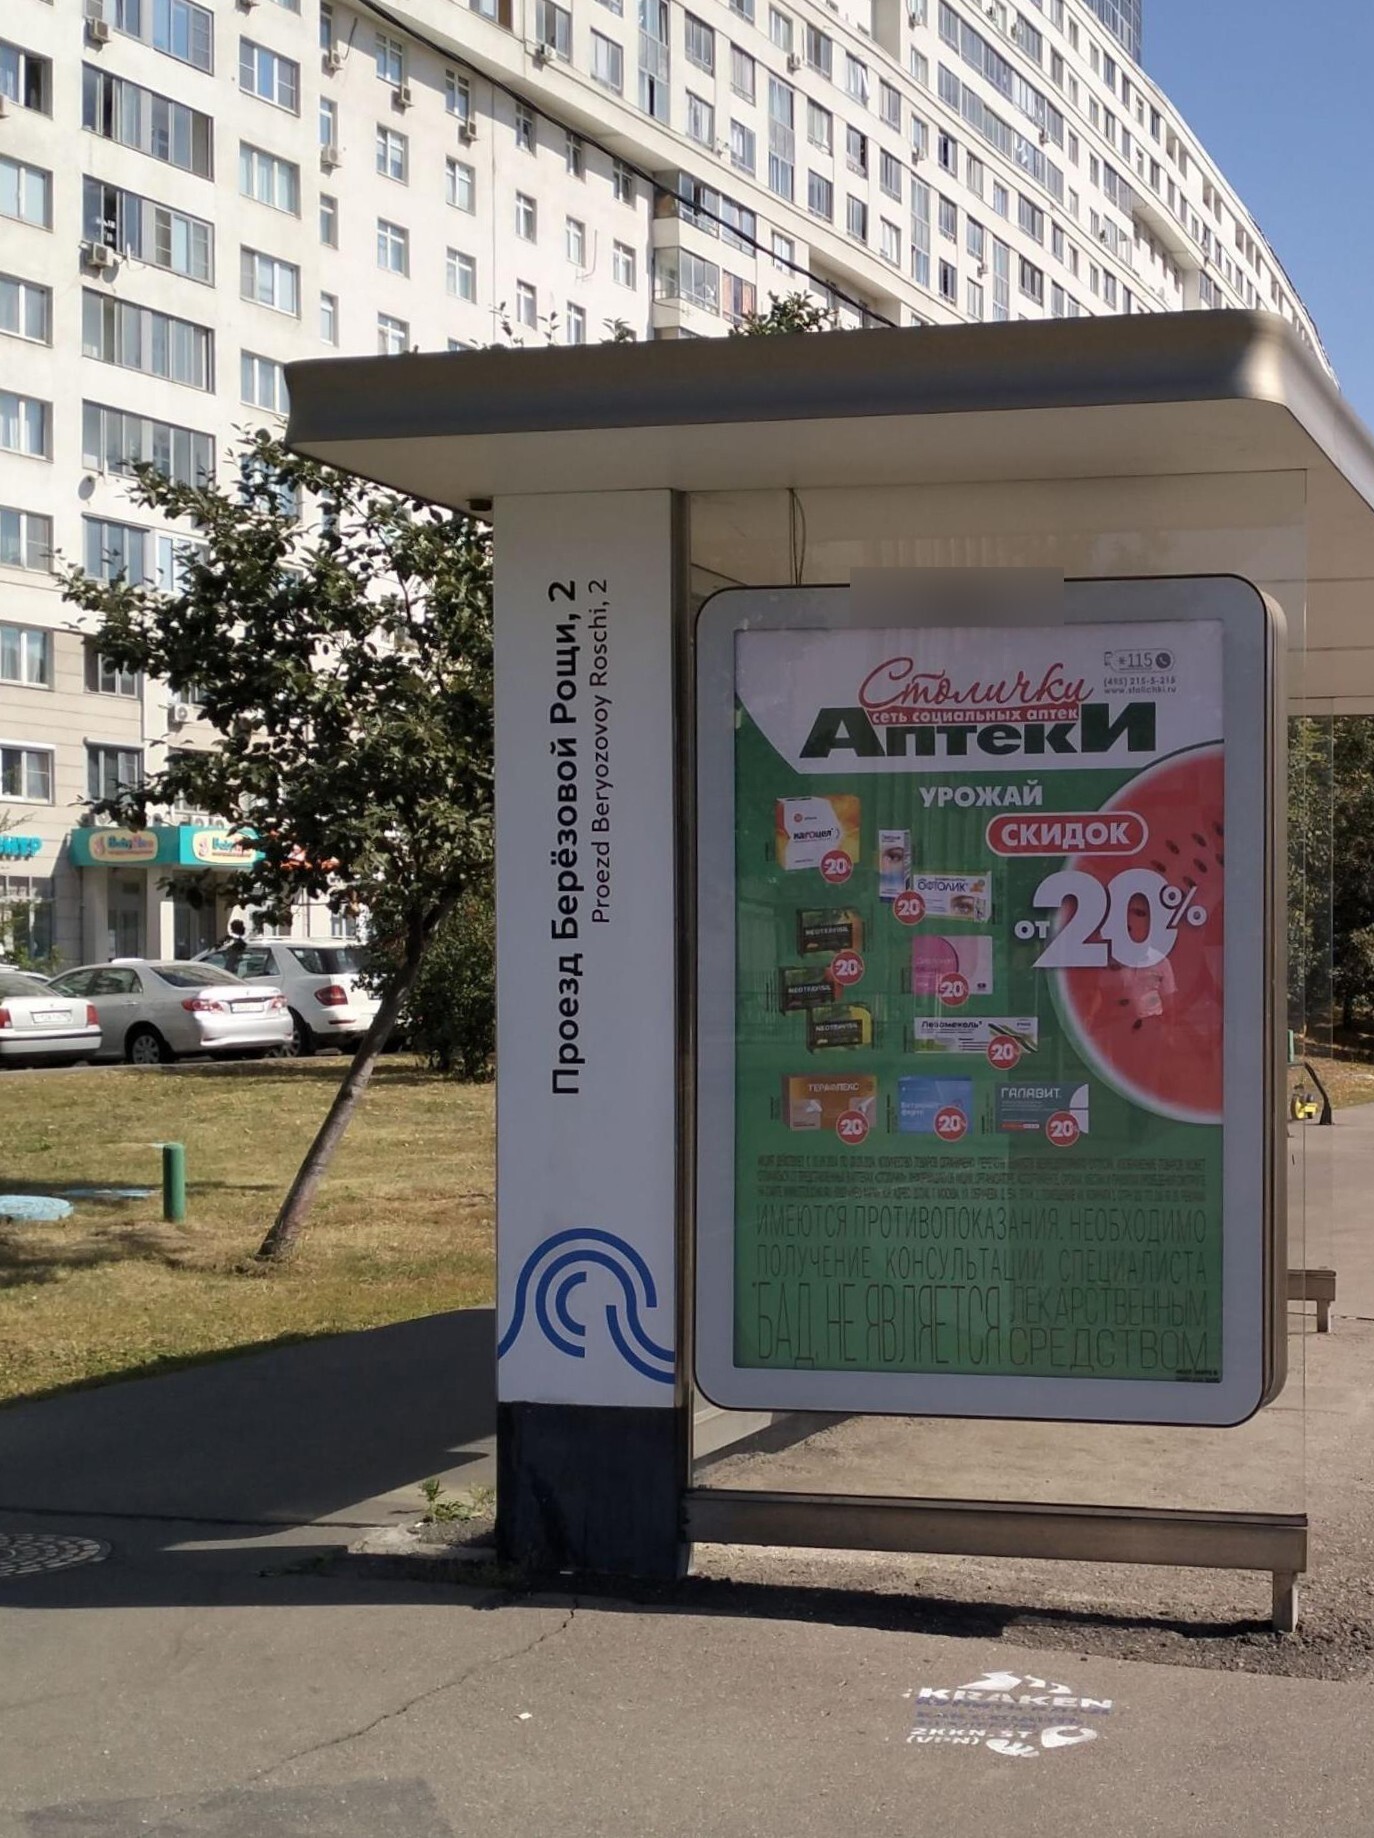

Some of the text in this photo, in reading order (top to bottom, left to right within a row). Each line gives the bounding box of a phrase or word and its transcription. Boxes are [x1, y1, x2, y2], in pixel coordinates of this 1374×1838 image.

[858, 657, 1094, 709] Столички
[872, 709, 1079, 724] сеть социальных аптек
[588, 579, 613, 922] Proezd Beryozovoy Roschi, 2
[919, 780, 1043, 809] УРОЖАЙ
[548, 580, 585, 1094] Проезд Берёзовой Рощи, 2
[1001, 822, 1130, 850] СКИДОК
[1032, 868, 1207, 968] 20%
[757, 1204, 1207, 1246] ИМЕЮТСЯ ПРОТИВОПОКАЗАНИЯ. НЕОБХОДИМО
[757, 1244, 1207, 1285] ПОЛУЧЕНИЕ КОНСУЛЬТАЦИИ СПЕЦИАЛИСТА
[827, 1284, 857, 1362] НЕ
[866, 1284, 1000, 1365] ЯВЛЯЕТСЯ
[1010, 1286, 1208, 1327] ЛЕКАРСТВЕННЫМ
[1009, 1327, 1208, 1372] СРЕДСТВОМ
[918, 1687, 1113, 1709] KRAKEN
